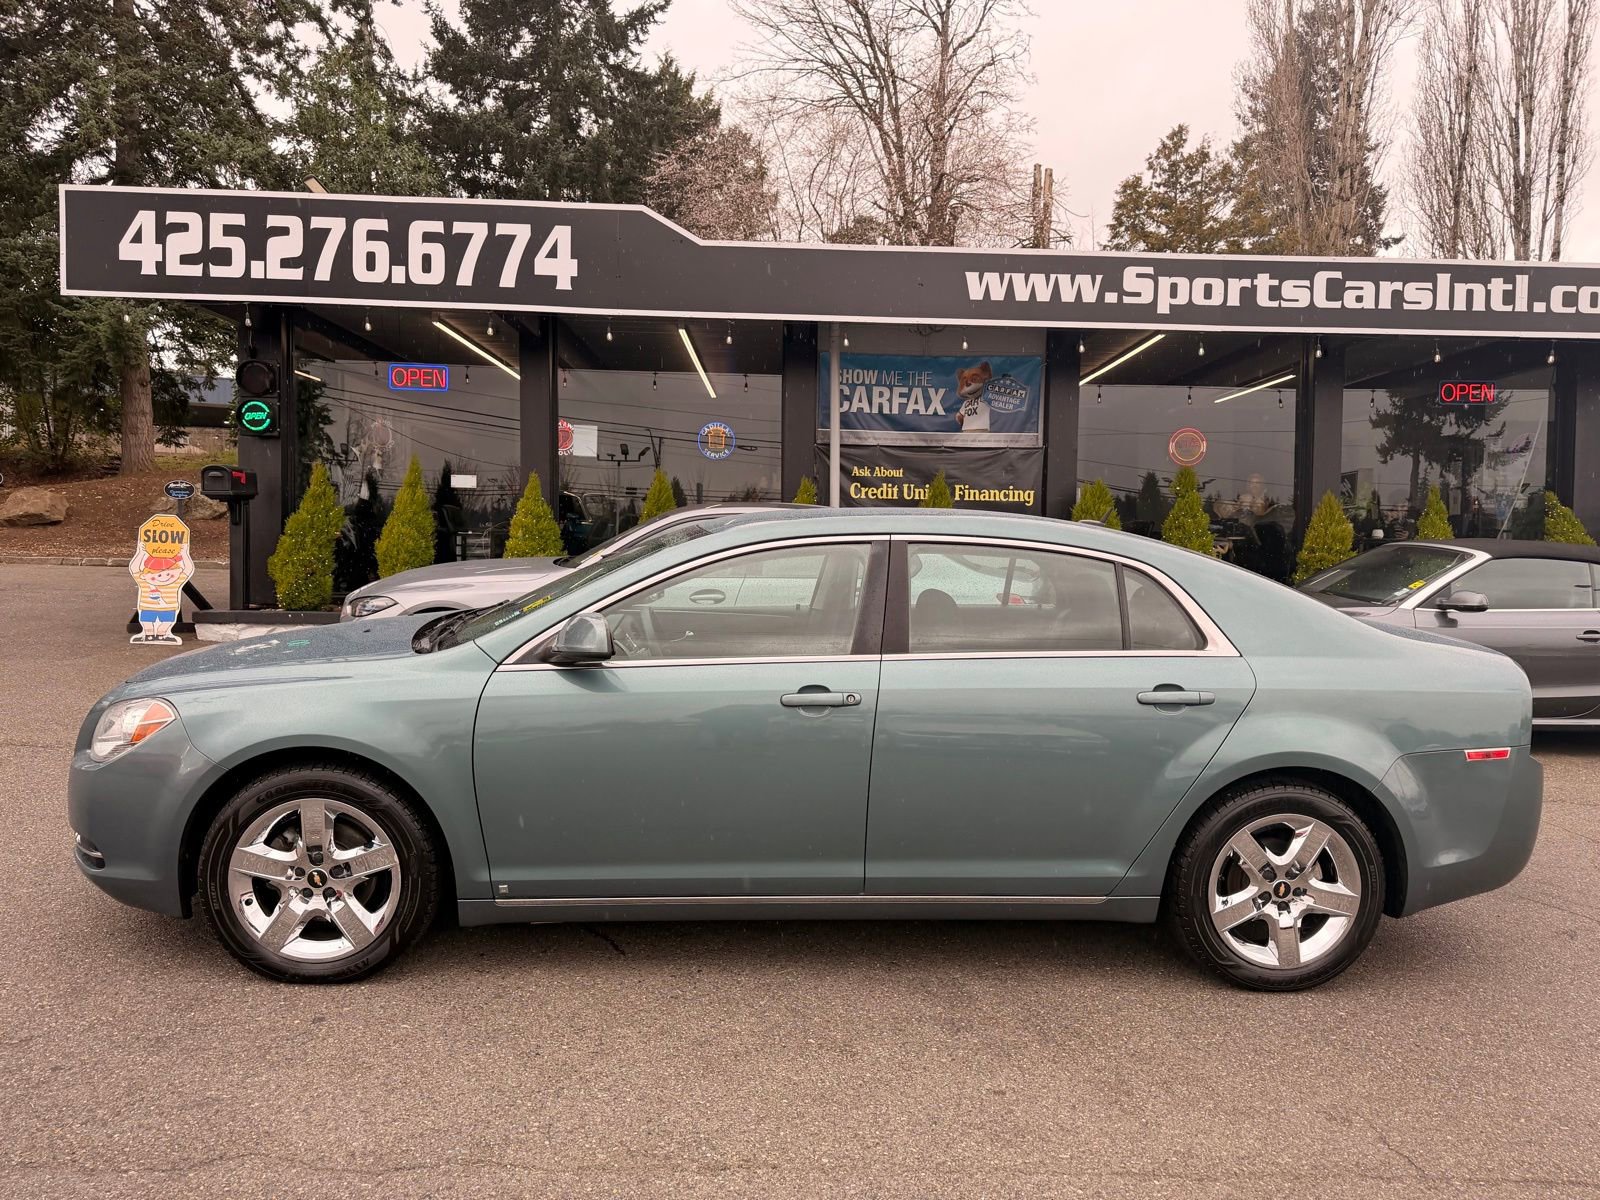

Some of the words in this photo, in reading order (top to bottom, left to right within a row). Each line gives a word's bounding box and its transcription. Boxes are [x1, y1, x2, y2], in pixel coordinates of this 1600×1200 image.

[118, 210, 579, 290] 425.276.6774
[391, 367, 446, 388] OPEN
[840, 368, 878, 385] HOW
[882, 370, 903, 385] ME
[908, 371, 934, 386] THE
[987, 384, 1025, 398] CARFAX
[1441, 383, 1495, 402] OPEN
[987, 393, 1021, 405] ADVANTAGE
[991, 401, 1014, 410] DEALER
[245, 411, 268, 421] OPEN
[701, 422, 733, 437] CADILLAC
[704, 449, 730, 459] SERVICE
[852, 466, 871, 477] Ask
[873, 467, 904, 478] About
[850, 483, 899, 500] Credit
[954, 485, 1035, 506] Financing
[152, 520, 175, 528] Drive
[143, 529, 185, 544] SLOW
[152, 547, 176, 555] please
